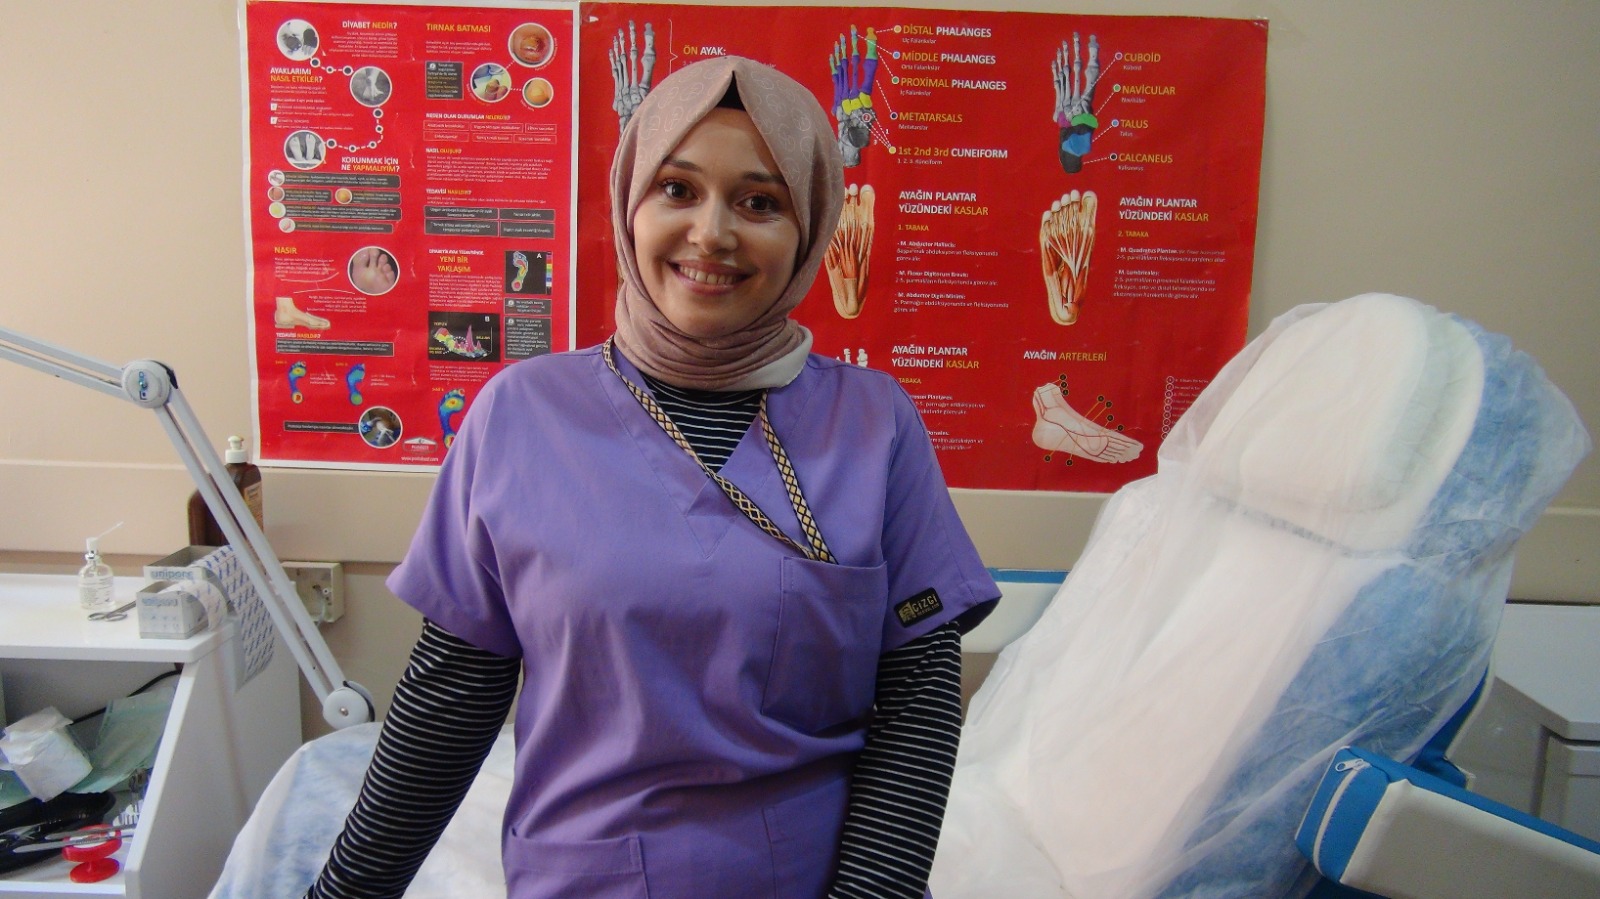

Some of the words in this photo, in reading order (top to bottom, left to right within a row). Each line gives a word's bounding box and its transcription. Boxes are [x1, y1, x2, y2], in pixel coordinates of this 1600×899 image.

[342, 20, 371, 29] DİYABET
[372, 21, 398, 30] NEDİR?
[426, 23, 455, 31] TIRNAK
[457, 24, 491, 33] BATMASI
[903, 24, 934, 36] DİSTAL
[936, 27, 992, 38] PHALANGES
[683, 45, 698, 55] ÖN
[700, 47, 726, 56] AYAK:
[902, 50, 939, 62] MİDDLE
[941, 55, 996, 65] PHALANGES
[1124, 52, 1162, 63] CUBOİD
[270, 67, 312, 75] AYAKLARIMI
[292, 74, 323, 83] ETKİLER?
[901, 76, 949, 88] PROXİMAL
[951, 80, 1007, 91] PHALANGES
[1122, 84, 1176, 95] NAVİCULAR
[899, 112, 963, 123] METATARSALS
[1120, 119, 1149, 129] TALUS
[898, 147, 911, 156] 1st
[914, 147, 931, 156] 2nd
[934, 147, 949, 156] 3rd
[951, 148, 1008, 158] CUNEIFORM
[341, 156, 382, 164] KORUNMAK
[384, 157, 399, 166] İÇİN
[1118, 153, 1173, 164] CALCANEUS
[898, 189, 933, 200] AYAĞIN
[935, 192, 977, 202] PLANTAR
[1119, 196, 1153, 207] AYAĞIN
[1156, 198, 1197, 208] PLANTAR
[898, 203, 952, 215] YÜZÜNDEKİ
[954, 206, 989, 216] KASLAR
[1119, 209, 1173, 221] YÜZÜNDEKİ
[1174, 212, 1209, 222] KASLAR
[274, 246, 297, 254] NASIR
[891, 343, 925, 355] AYAĞIN
[927, 346, 968, 356] PLANTAR
[1023, 349, 1057, 360] AYAĞIN
[1058, 350, 1108, 362] ARTERLERİ
[891, 357, 944, 369] YÜZÜNDEKİ
[945, 359, 980, 369] KASLAR
